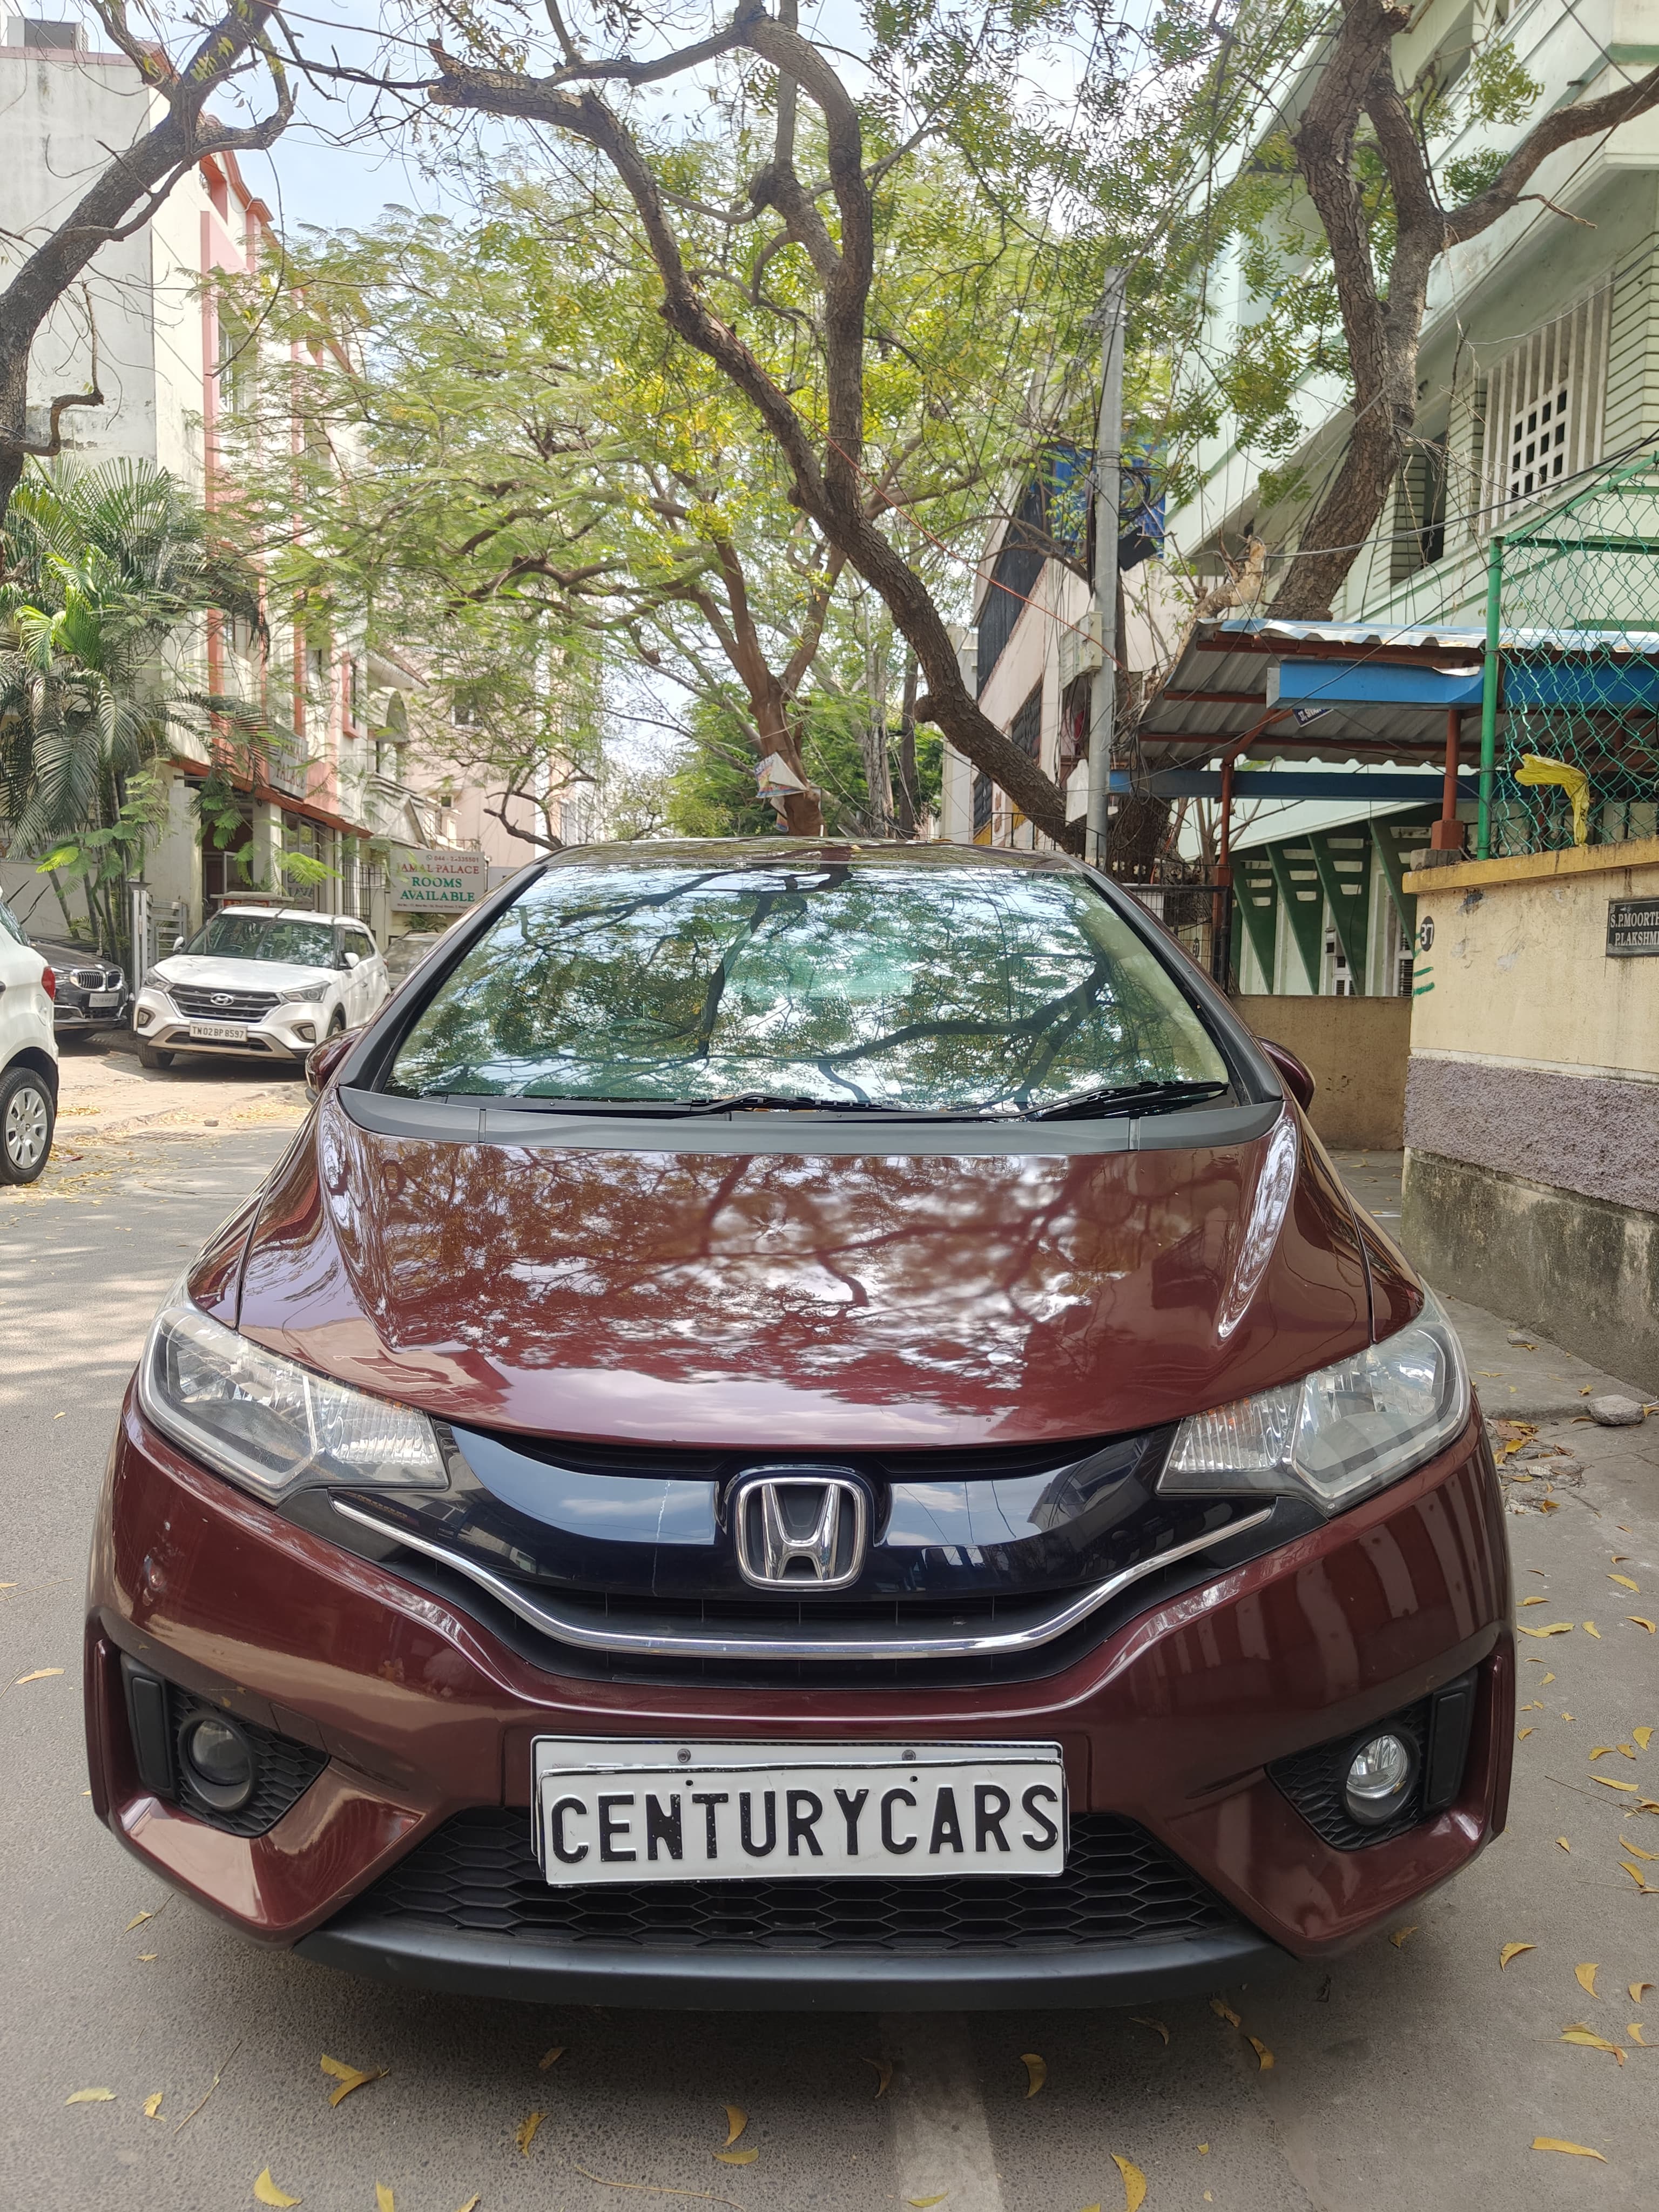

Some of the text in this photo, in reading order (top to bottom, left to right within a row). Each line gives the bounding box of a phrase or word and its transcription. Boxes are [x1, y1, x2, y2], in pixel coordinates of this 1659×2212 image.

[436, 865, 480, 874] PALACE
[412, 876, 462, 888] ROOMS
[400, 890, 475, 902] AVAILABLE
[1421, 923, 1433, 945] 37
[1614, 931, 1659, 946] P.LAKSHM
[551, 1784, 1058, 1863] CENTURYCARS
